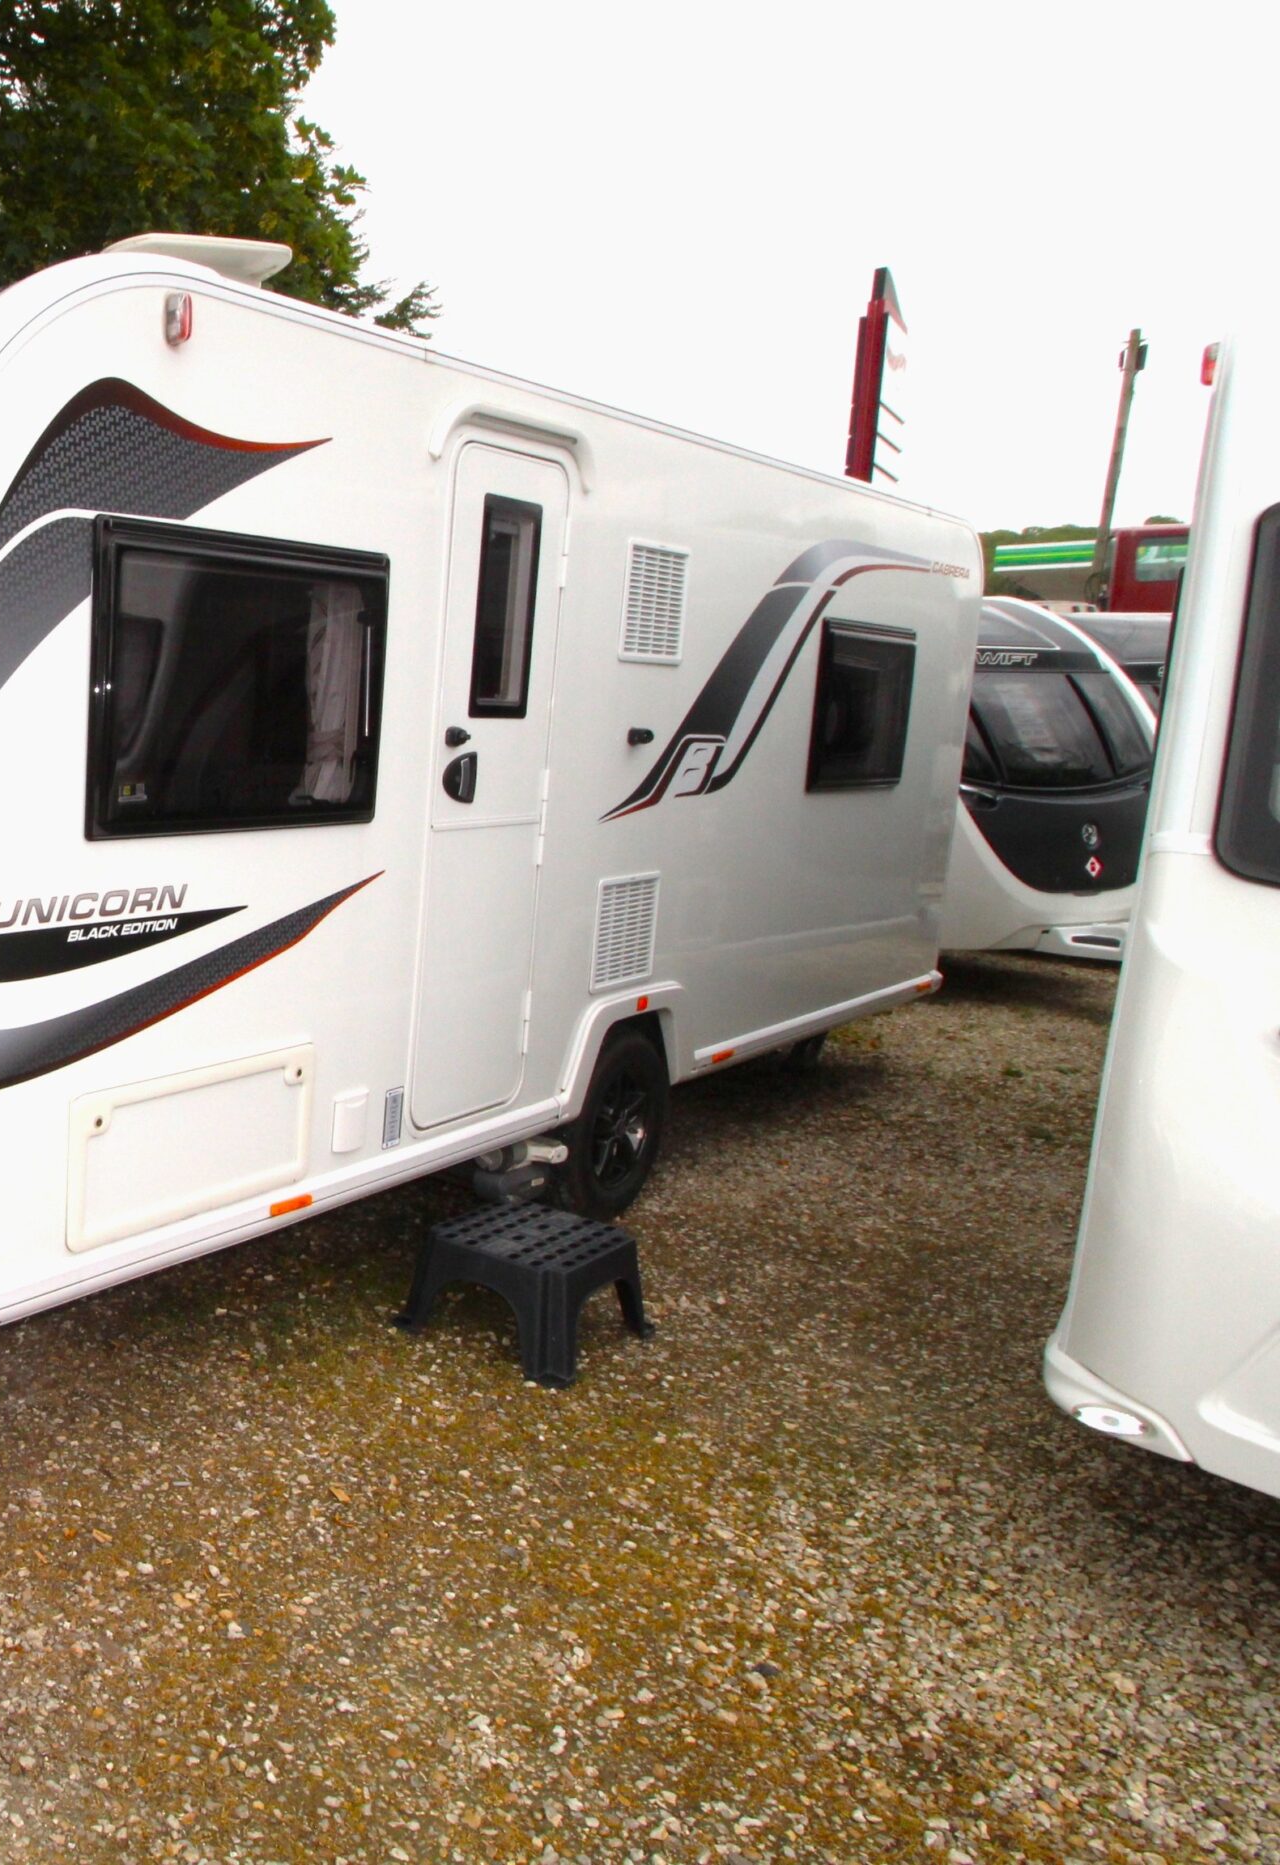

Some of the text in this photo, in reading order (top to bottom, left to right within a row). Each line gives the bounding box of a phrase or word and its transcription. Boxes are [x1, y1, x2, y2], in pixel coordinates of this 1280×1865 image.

[976, 652, 1038, 666] WIFT
[66, 918, 179, 943] BLACK EDITION
